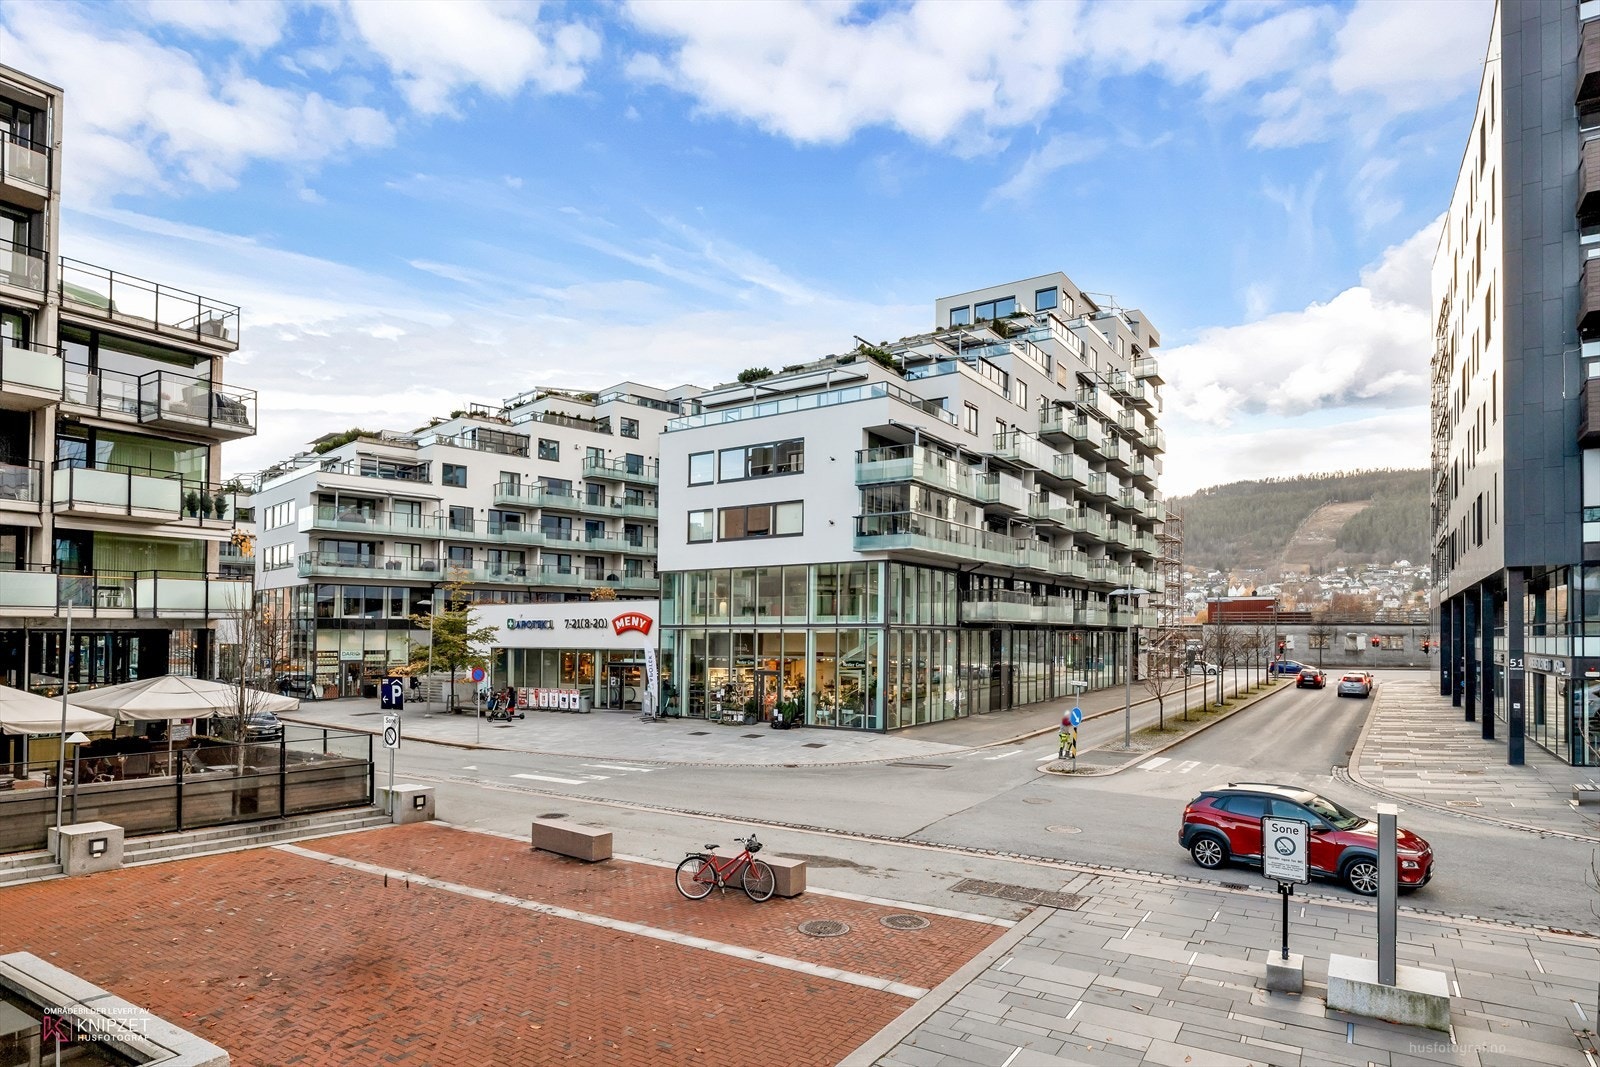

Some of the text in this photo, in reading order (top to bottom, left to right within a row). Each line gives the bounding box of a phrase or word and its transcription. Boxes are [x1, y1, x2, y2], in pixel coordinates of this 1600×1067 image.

[615, 616, 647, 629] MENY
[1510, 659, 1524, 667] 51
[392, 685, 402, 705] P
[1271, 823, 1299, 836] Sone
